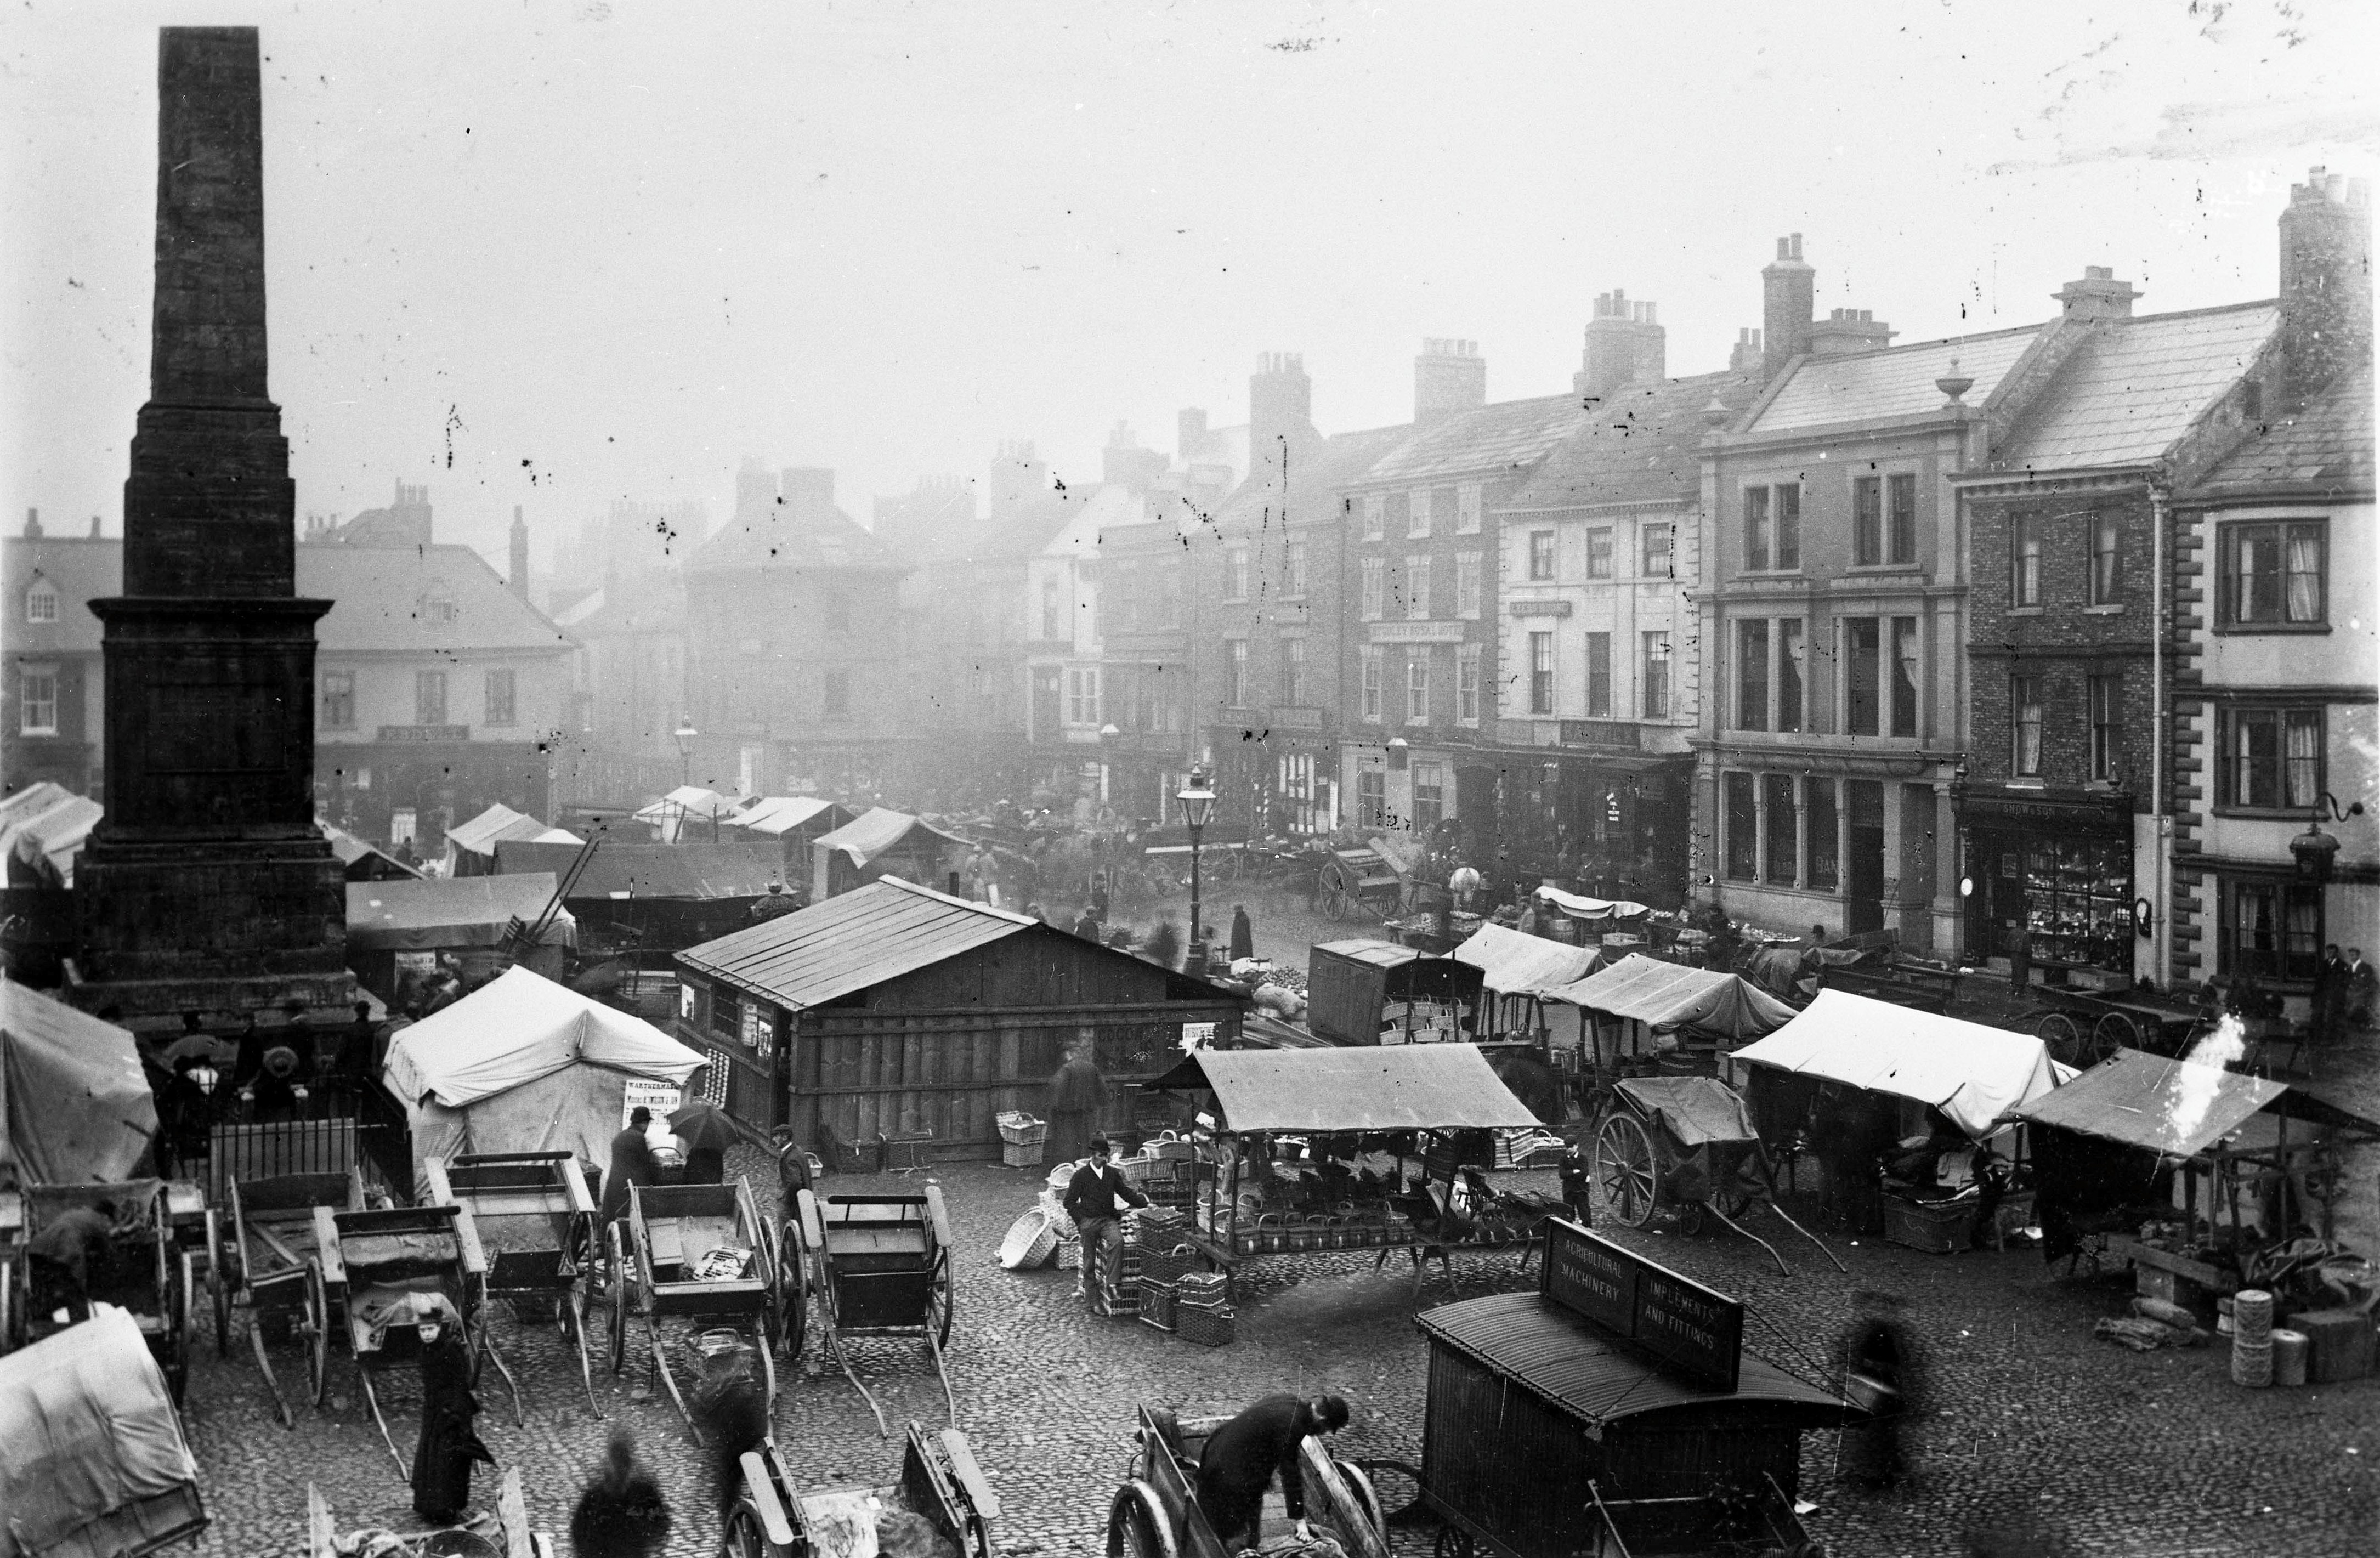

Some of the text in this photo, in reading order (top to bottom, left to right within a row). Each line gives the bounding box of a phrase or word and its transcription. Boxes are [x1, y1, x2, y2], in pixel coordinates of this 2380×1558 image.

[1816, 856, 1838, 874] BAN
[1565, 1240, 1622, 1278] AGRICULTURAL
[1562, 1262, 1618, 1301] MACHINERY
[1650, 1281, 1714, 1320] IMPLEMENTS
[1645, 1305, 1714, 1350] AND FITTINGS
